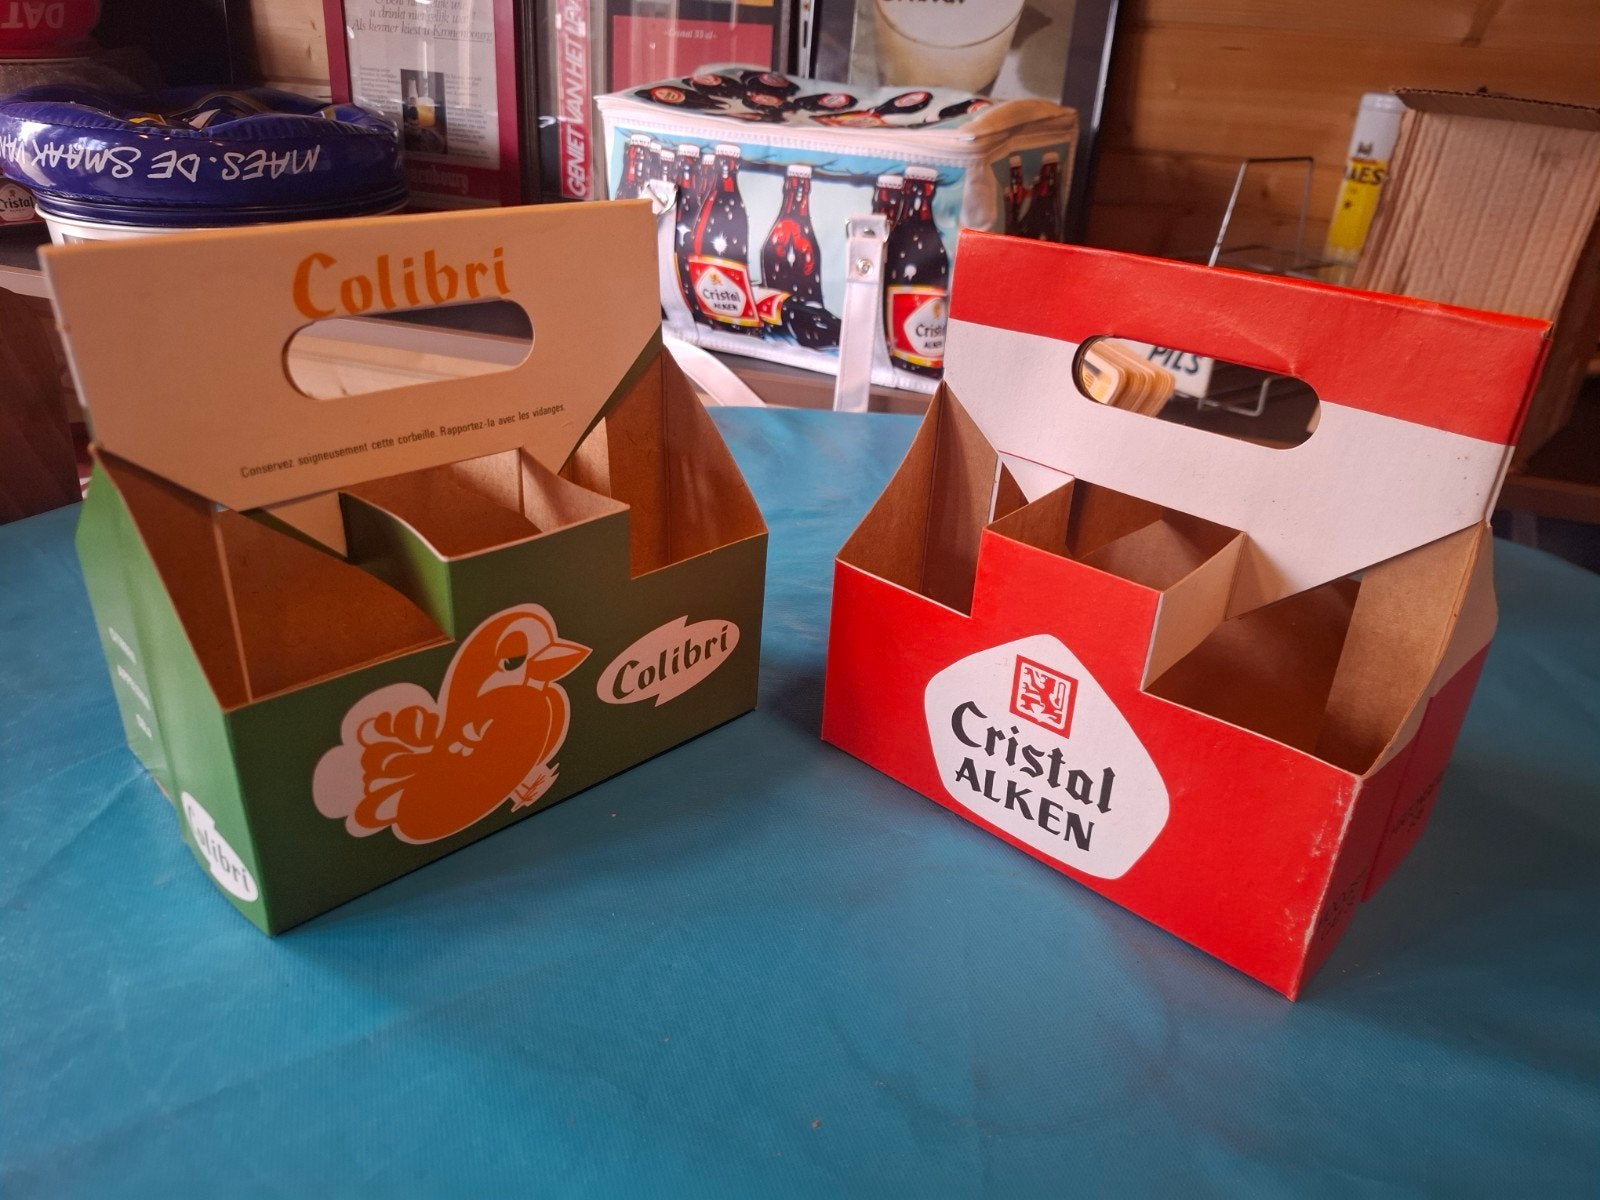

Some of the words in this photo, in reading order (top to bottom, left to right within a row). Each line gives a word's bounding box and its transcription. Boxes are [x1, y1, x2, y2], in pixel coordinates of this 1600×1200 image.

[352, 18, 366, 31] Als
[564, 35, 584, 85] HET
[564, 87, 585, 125] VAN
[31, 138, 141, 179] SMAAK
[147, 149, 200, 182] DE
[566, 127, 587, 198] GENIET
[292, 246, 511, 319] Colibri
[702, 288, 741, 302] Cristal
[1148, 347, 1205, 375] PILS
[240, 458, 294, 479] Conservez
[297, 442, 369, 466] soigneusement
[371, 436, 395, 450] cette
[440, 418, 496, 437] Rapportez-la
[498, 415, 516, 426] avec
[518, 411, 530, 421] les
[613, 625, 728, 700] Colibri
[951, 700, 1116, 814] Cristal
[955, 756, 1095, 852] ALKEN
